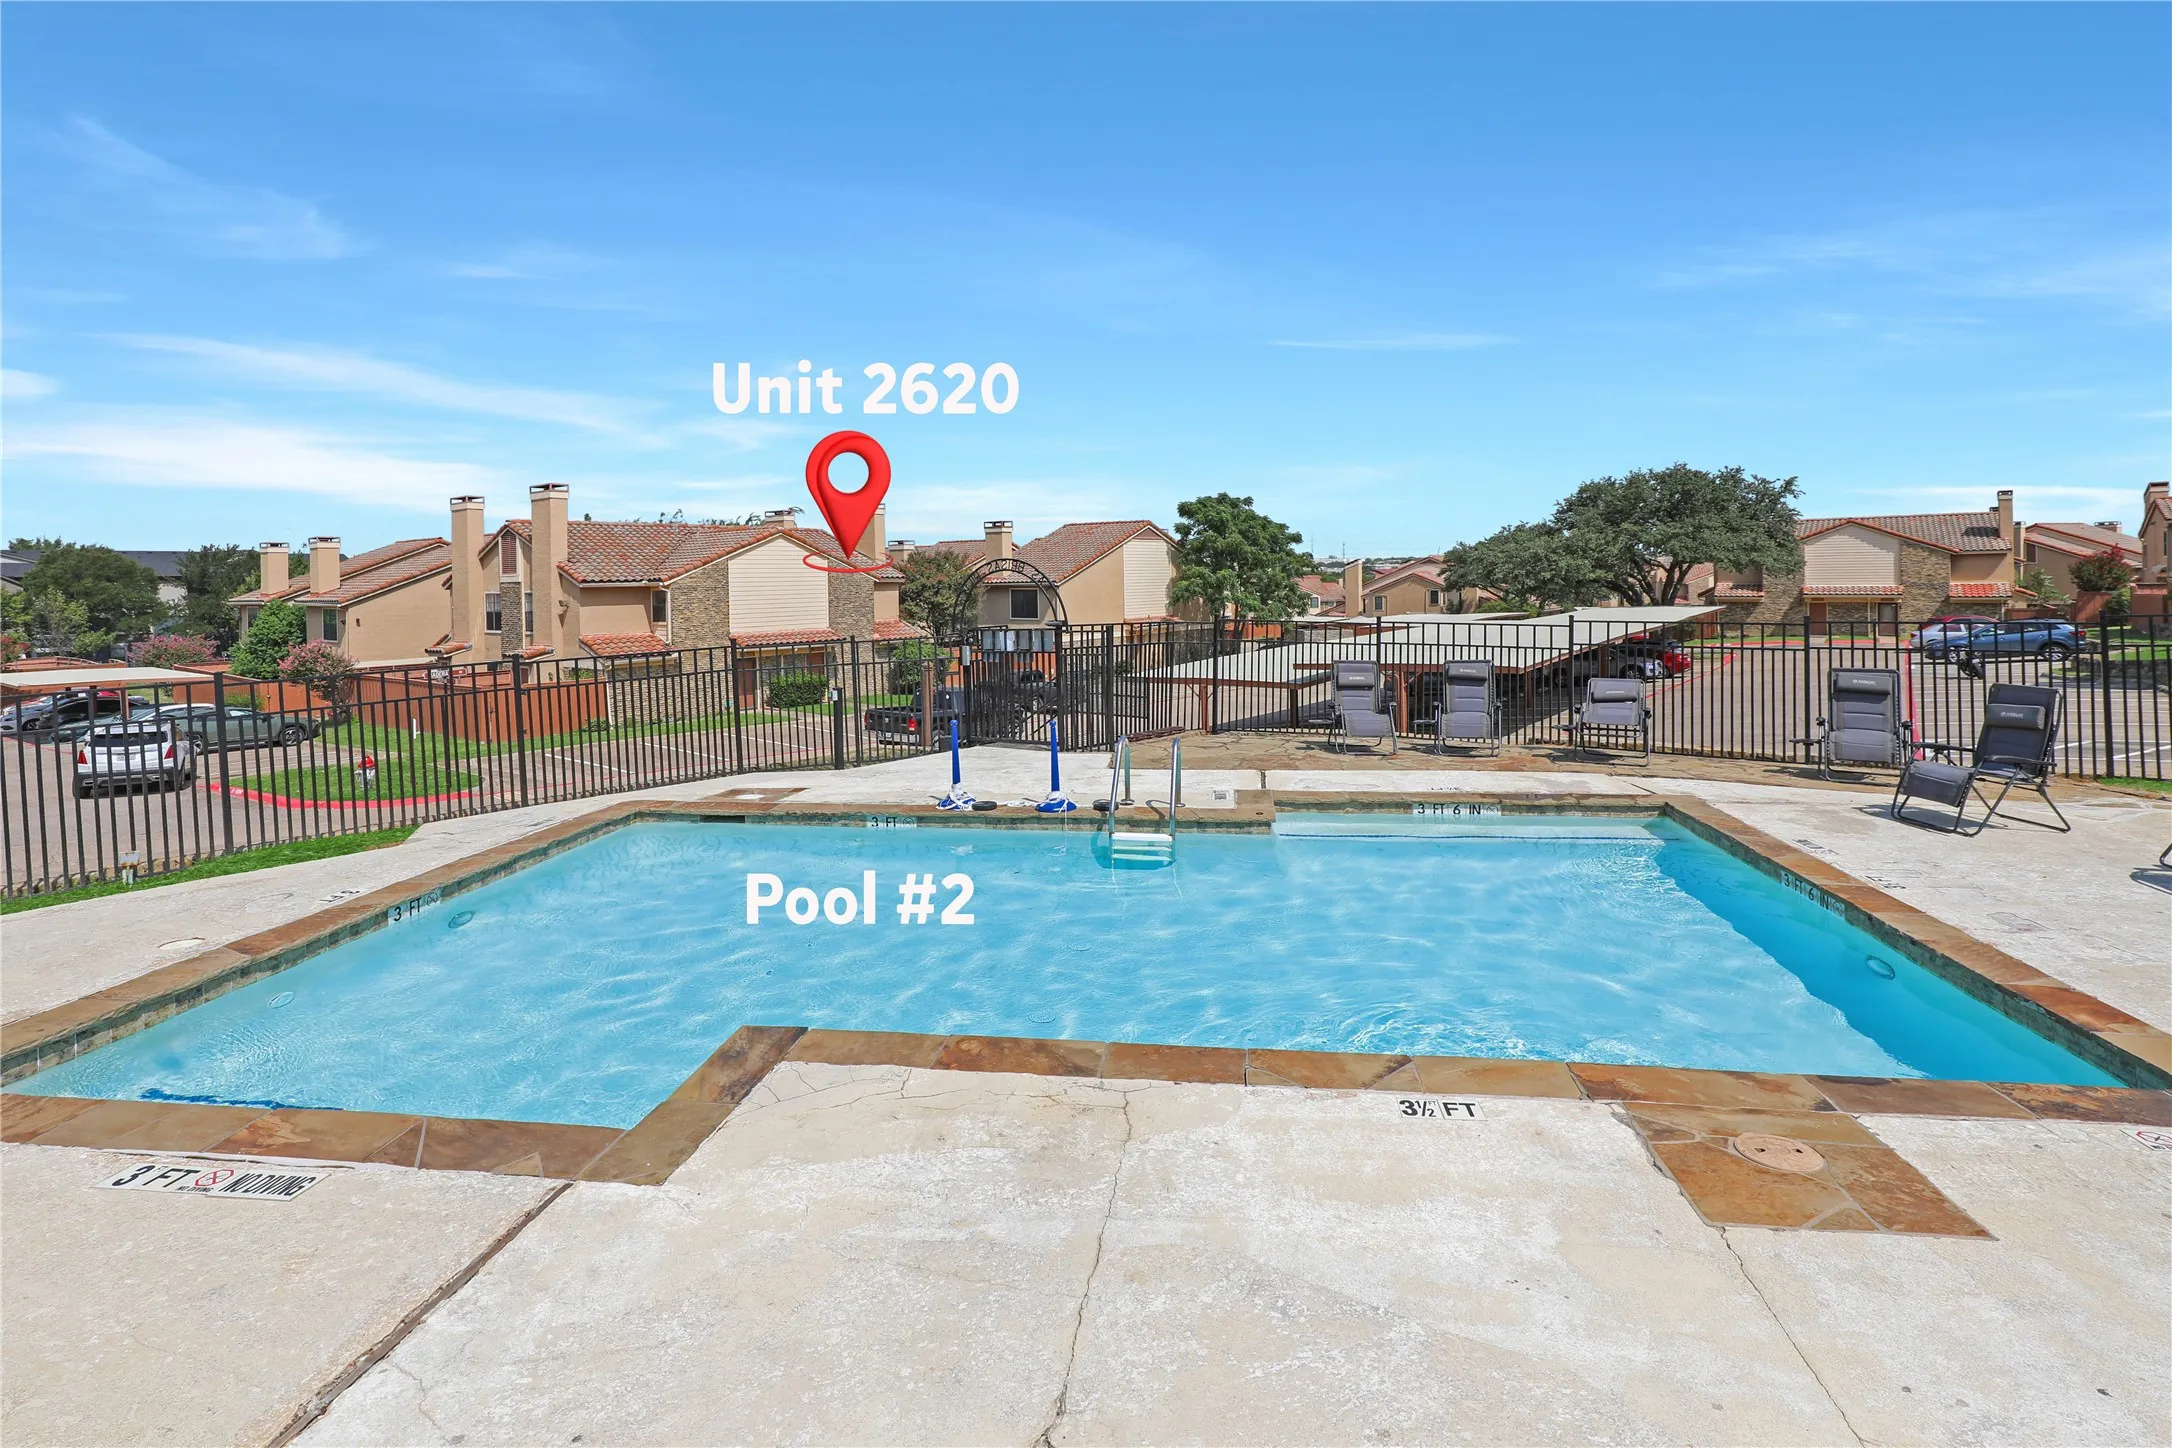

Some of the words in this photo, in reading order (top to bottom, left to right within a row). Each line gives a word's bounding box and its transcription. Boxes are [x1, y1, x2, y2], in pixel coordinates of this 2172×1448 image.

[1417, 803, 1426, 815] 3
[1433, 803, 1446, 815] FT
[1452, 804, 1461, 815] 6
[1469, 804, 1481, 815] IN
[871, 816, 879, 827] 3
[886, 816, 898, 828] FT
[1784, 873, 1790, 888] 3
[1794, 877, 1803, 895] FT
[1808, 887, 1815, 901] 6
[1819, 891, 1829, 911] IN
[393, 905, 402, 922] 3
[409, 897, 422, 917] FT
[1442, 1102, 1476, 1118] FT
[111, 1165, 156, 1187] 3
[143, 1168, 201, 1188] FT
[219, 1173, 263, 1193] NO
[241, 1175, 317, 1196] DIVING
